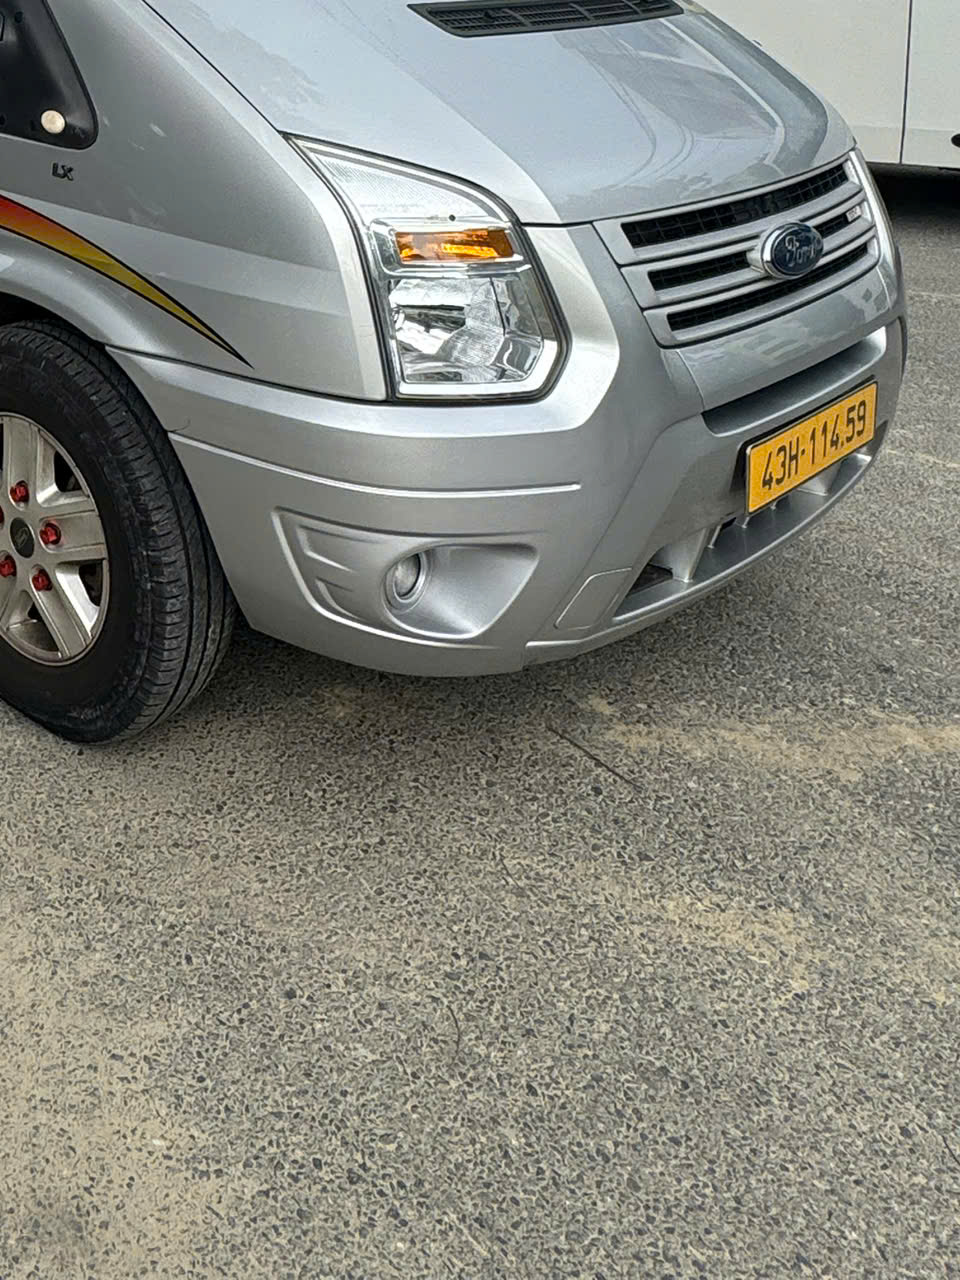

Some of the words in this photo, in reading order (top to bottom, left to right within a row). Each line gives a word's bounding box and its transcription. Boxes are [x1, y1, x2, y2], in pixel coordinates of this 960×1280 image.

[52, 162, 74, 181] LX
[784, 234, 818, 268] Ford
[762, 400, 867, 490] 43H-114.59
